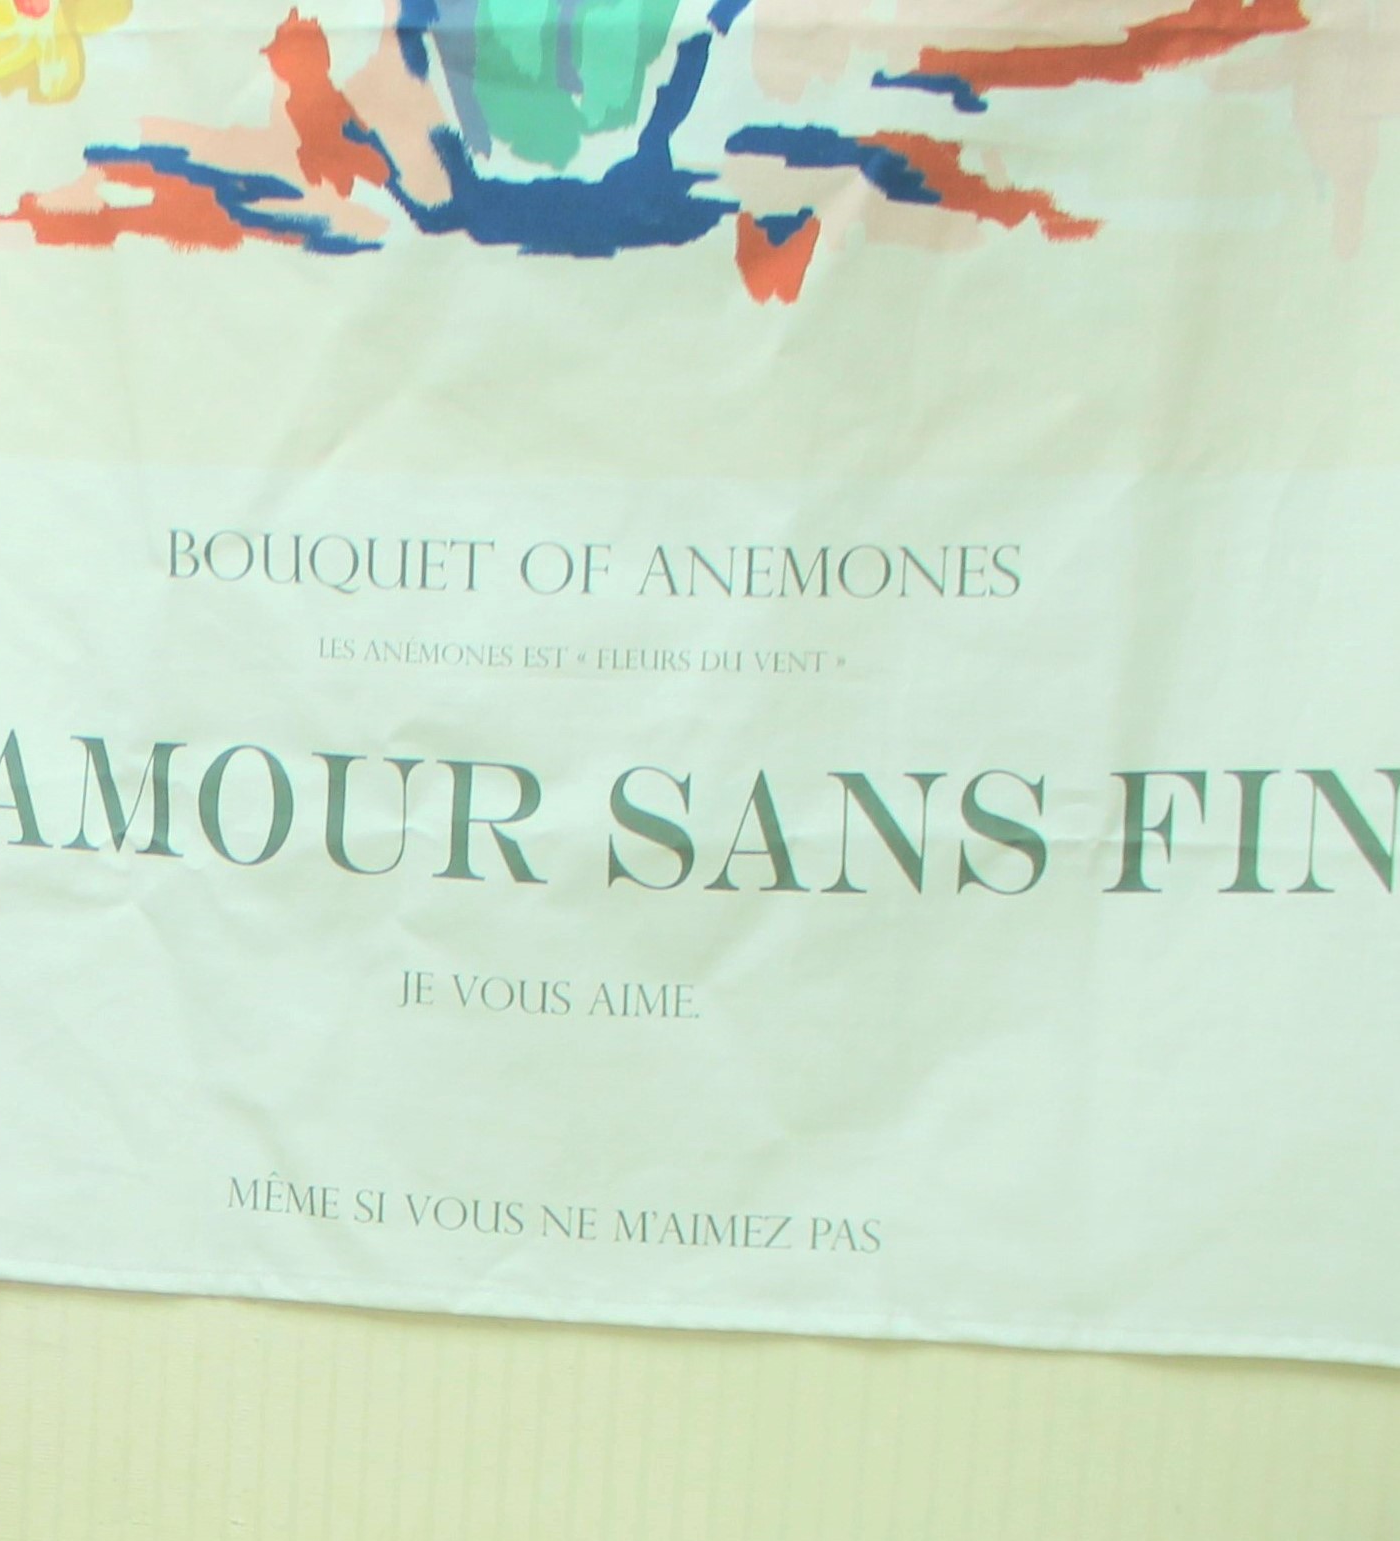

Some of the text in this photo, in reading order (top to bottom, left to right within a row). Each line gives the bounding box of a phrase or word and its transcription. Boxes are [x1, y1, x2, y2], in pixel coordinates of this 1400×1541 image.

[167, 528, 1022, 598] BOUQUET OF ANEMONES
[319, 636, 355, 660] LES
[523, 646, 569, 669] EST
[700, 650, 743, 673] DU
[754, 650, 829, 674] VENT
[607, 766, 1049, 896] SANS
[1102, 767, 1400, 894] FIN
[399, 970, 701, 1019] JE VOUS AIME.
[227, 1170, 340, 1220] MÊME
[353, 1190, 386, 1224] SI
[404, 1193, 525, 1235] VOUS
[540, 1204, 597, 1240] NE
[810, 1216, 882, 1253] PAS
